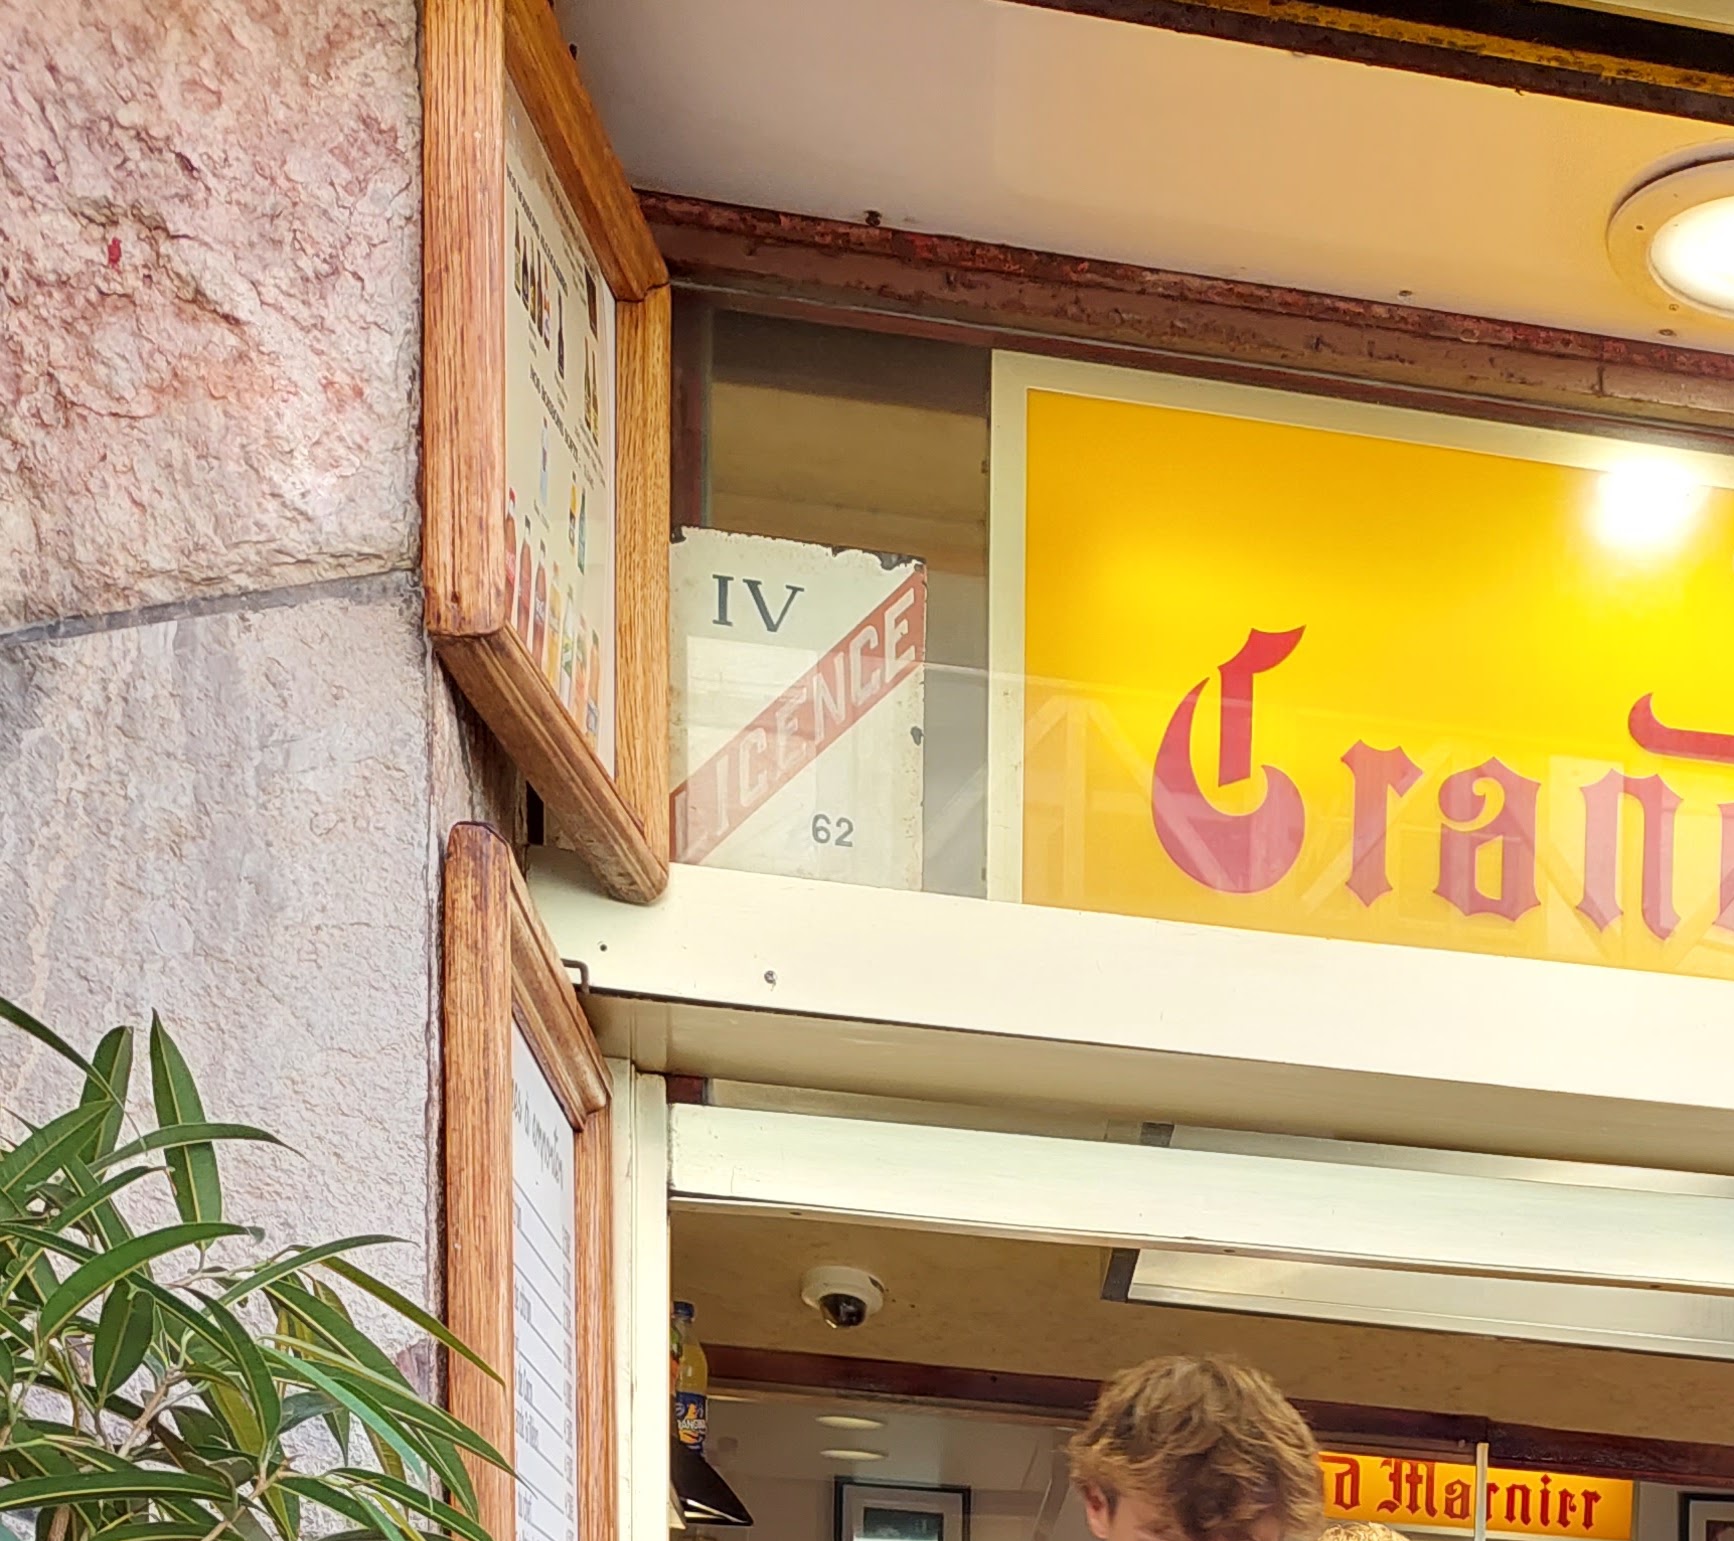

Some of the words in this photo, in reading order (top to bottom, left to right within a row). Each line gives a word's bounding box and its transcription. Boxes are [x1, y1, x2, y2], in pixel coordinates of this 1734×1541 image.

[712, 573, 805, 633] IV
[673, 586, 916, 863] LICENCE
[811, 813, 854, 848] 62
[1376, 1456, 1603, 1531] Marnier
